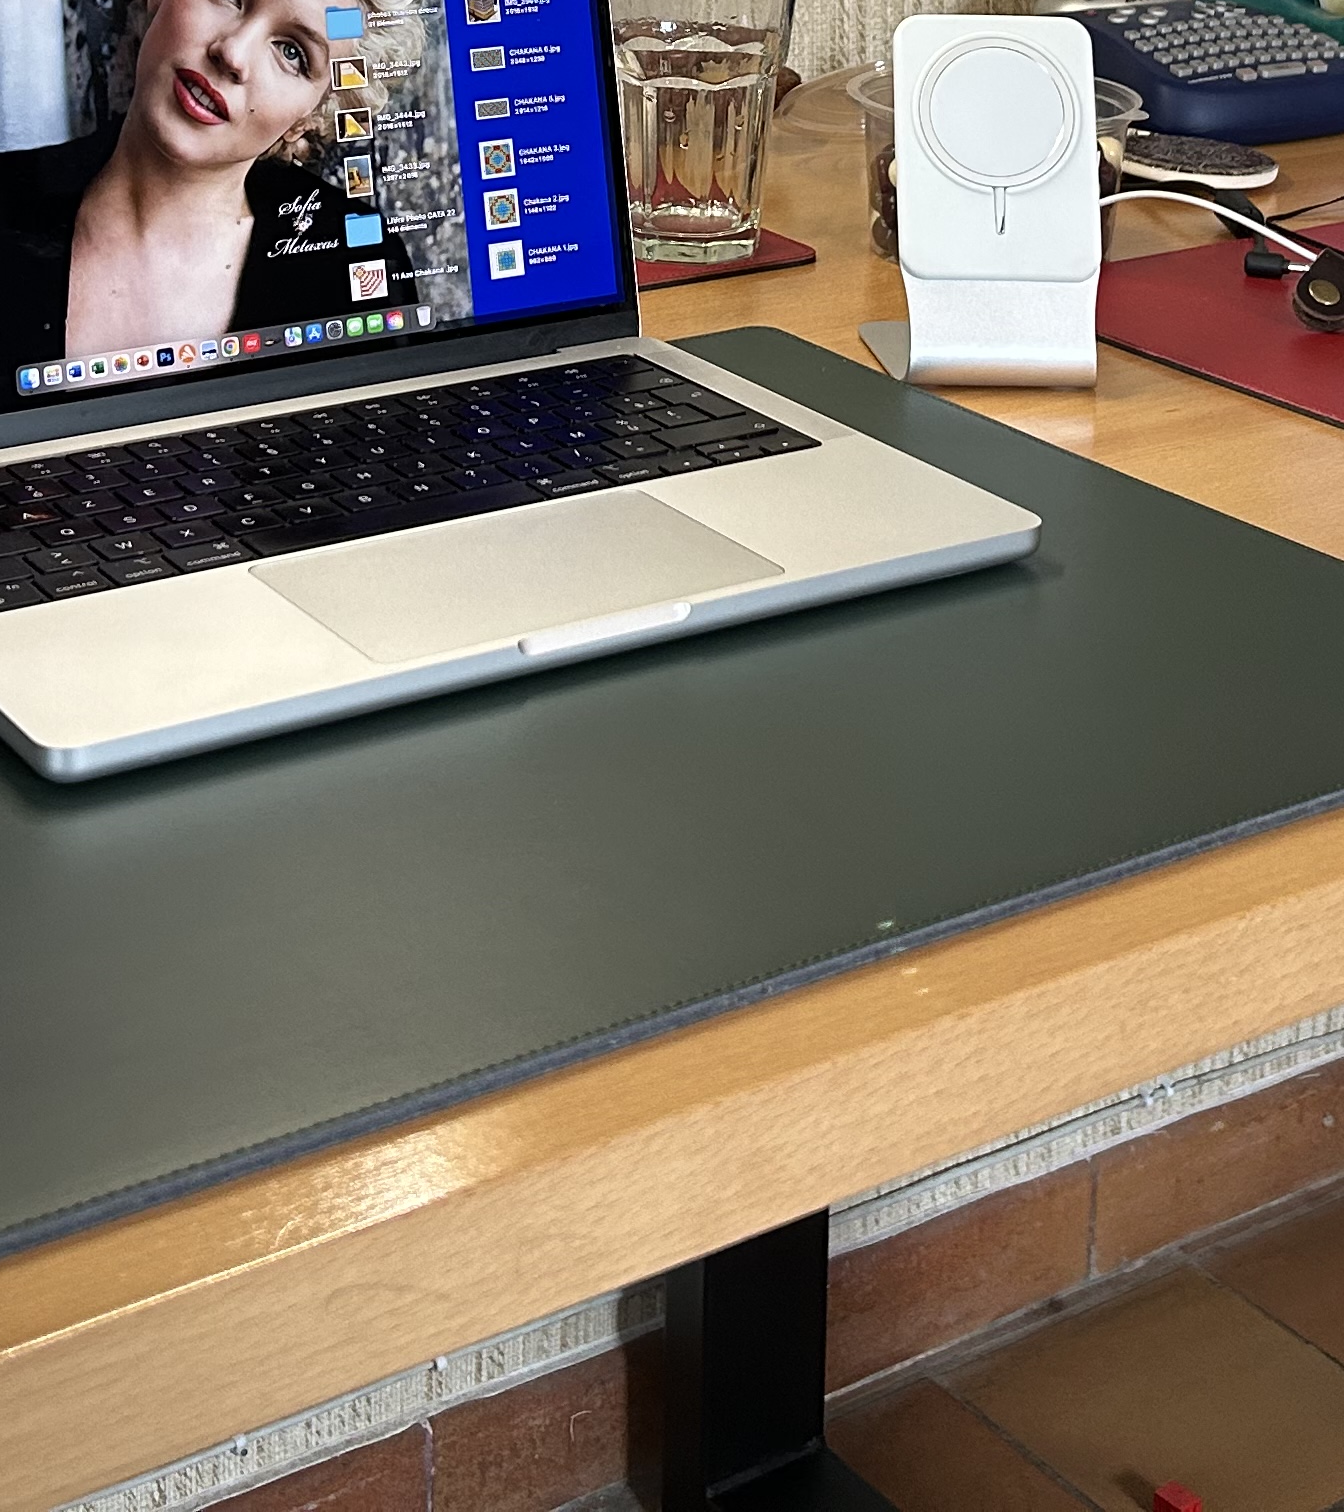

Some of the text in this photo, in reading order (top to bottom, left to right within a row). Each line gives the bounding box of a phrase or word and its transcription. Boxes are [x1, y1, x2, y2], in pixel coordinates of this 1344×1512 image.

[278, 188, 322, 221] Sofia
[159, 352, 172, 363] Ps
[186, 551, 241, 566] command
[125, 567, 163, 579] option
[56, 579, 98, 593] control
